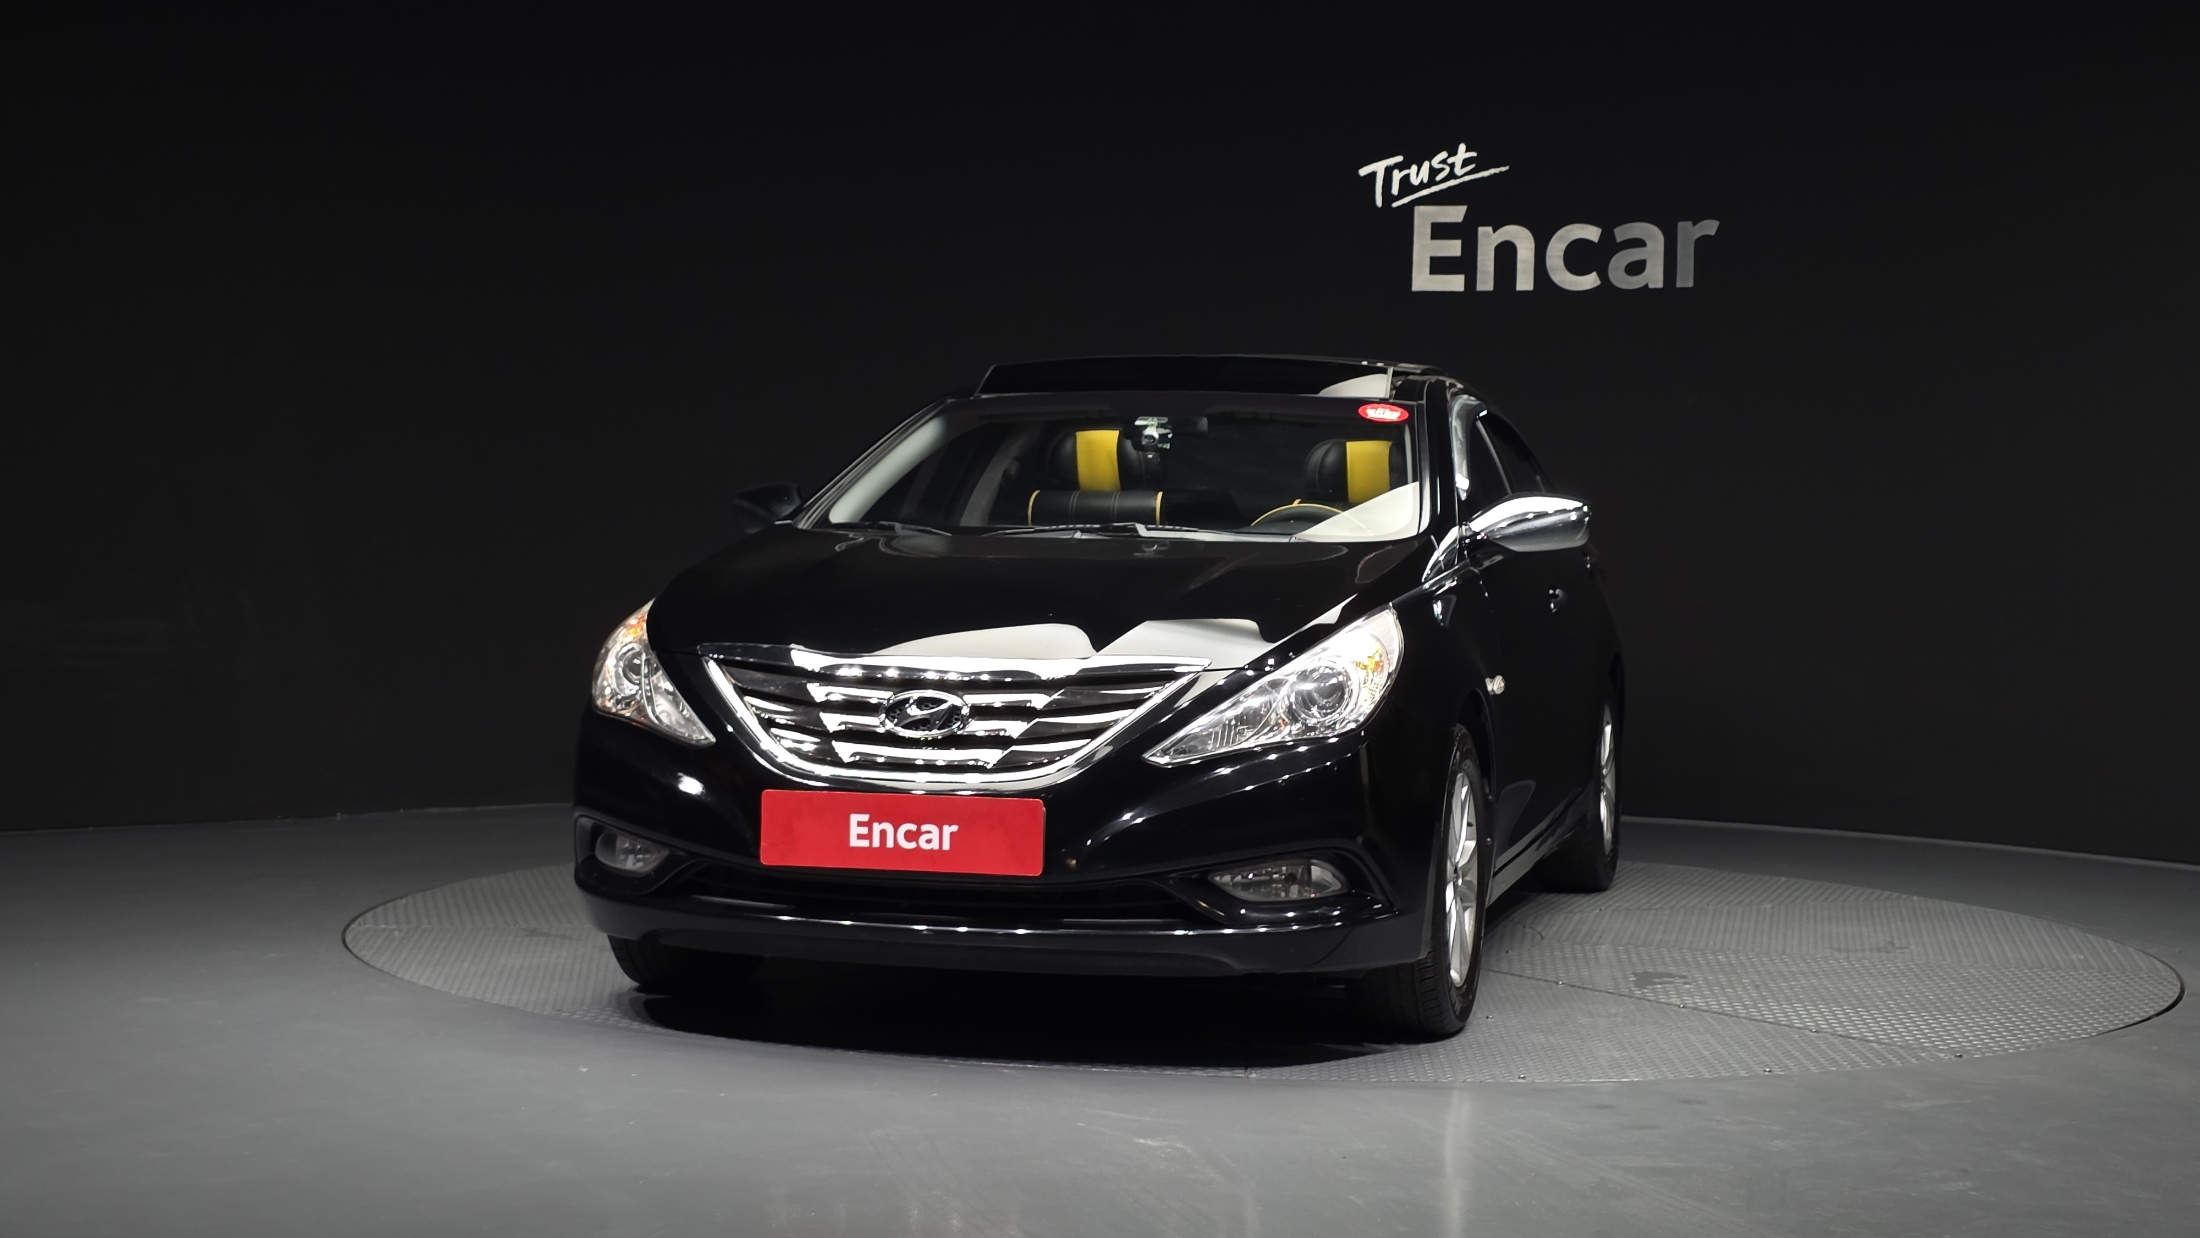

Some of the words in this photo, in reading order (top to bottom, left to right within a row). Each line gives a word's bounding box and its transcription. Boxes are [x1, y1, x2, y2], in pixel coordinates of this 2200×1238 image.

[1357, 142, 1478, 208] Trust
[1411, 204, 1720, 292] Encar
[849, 813, 959, 851] Encar
